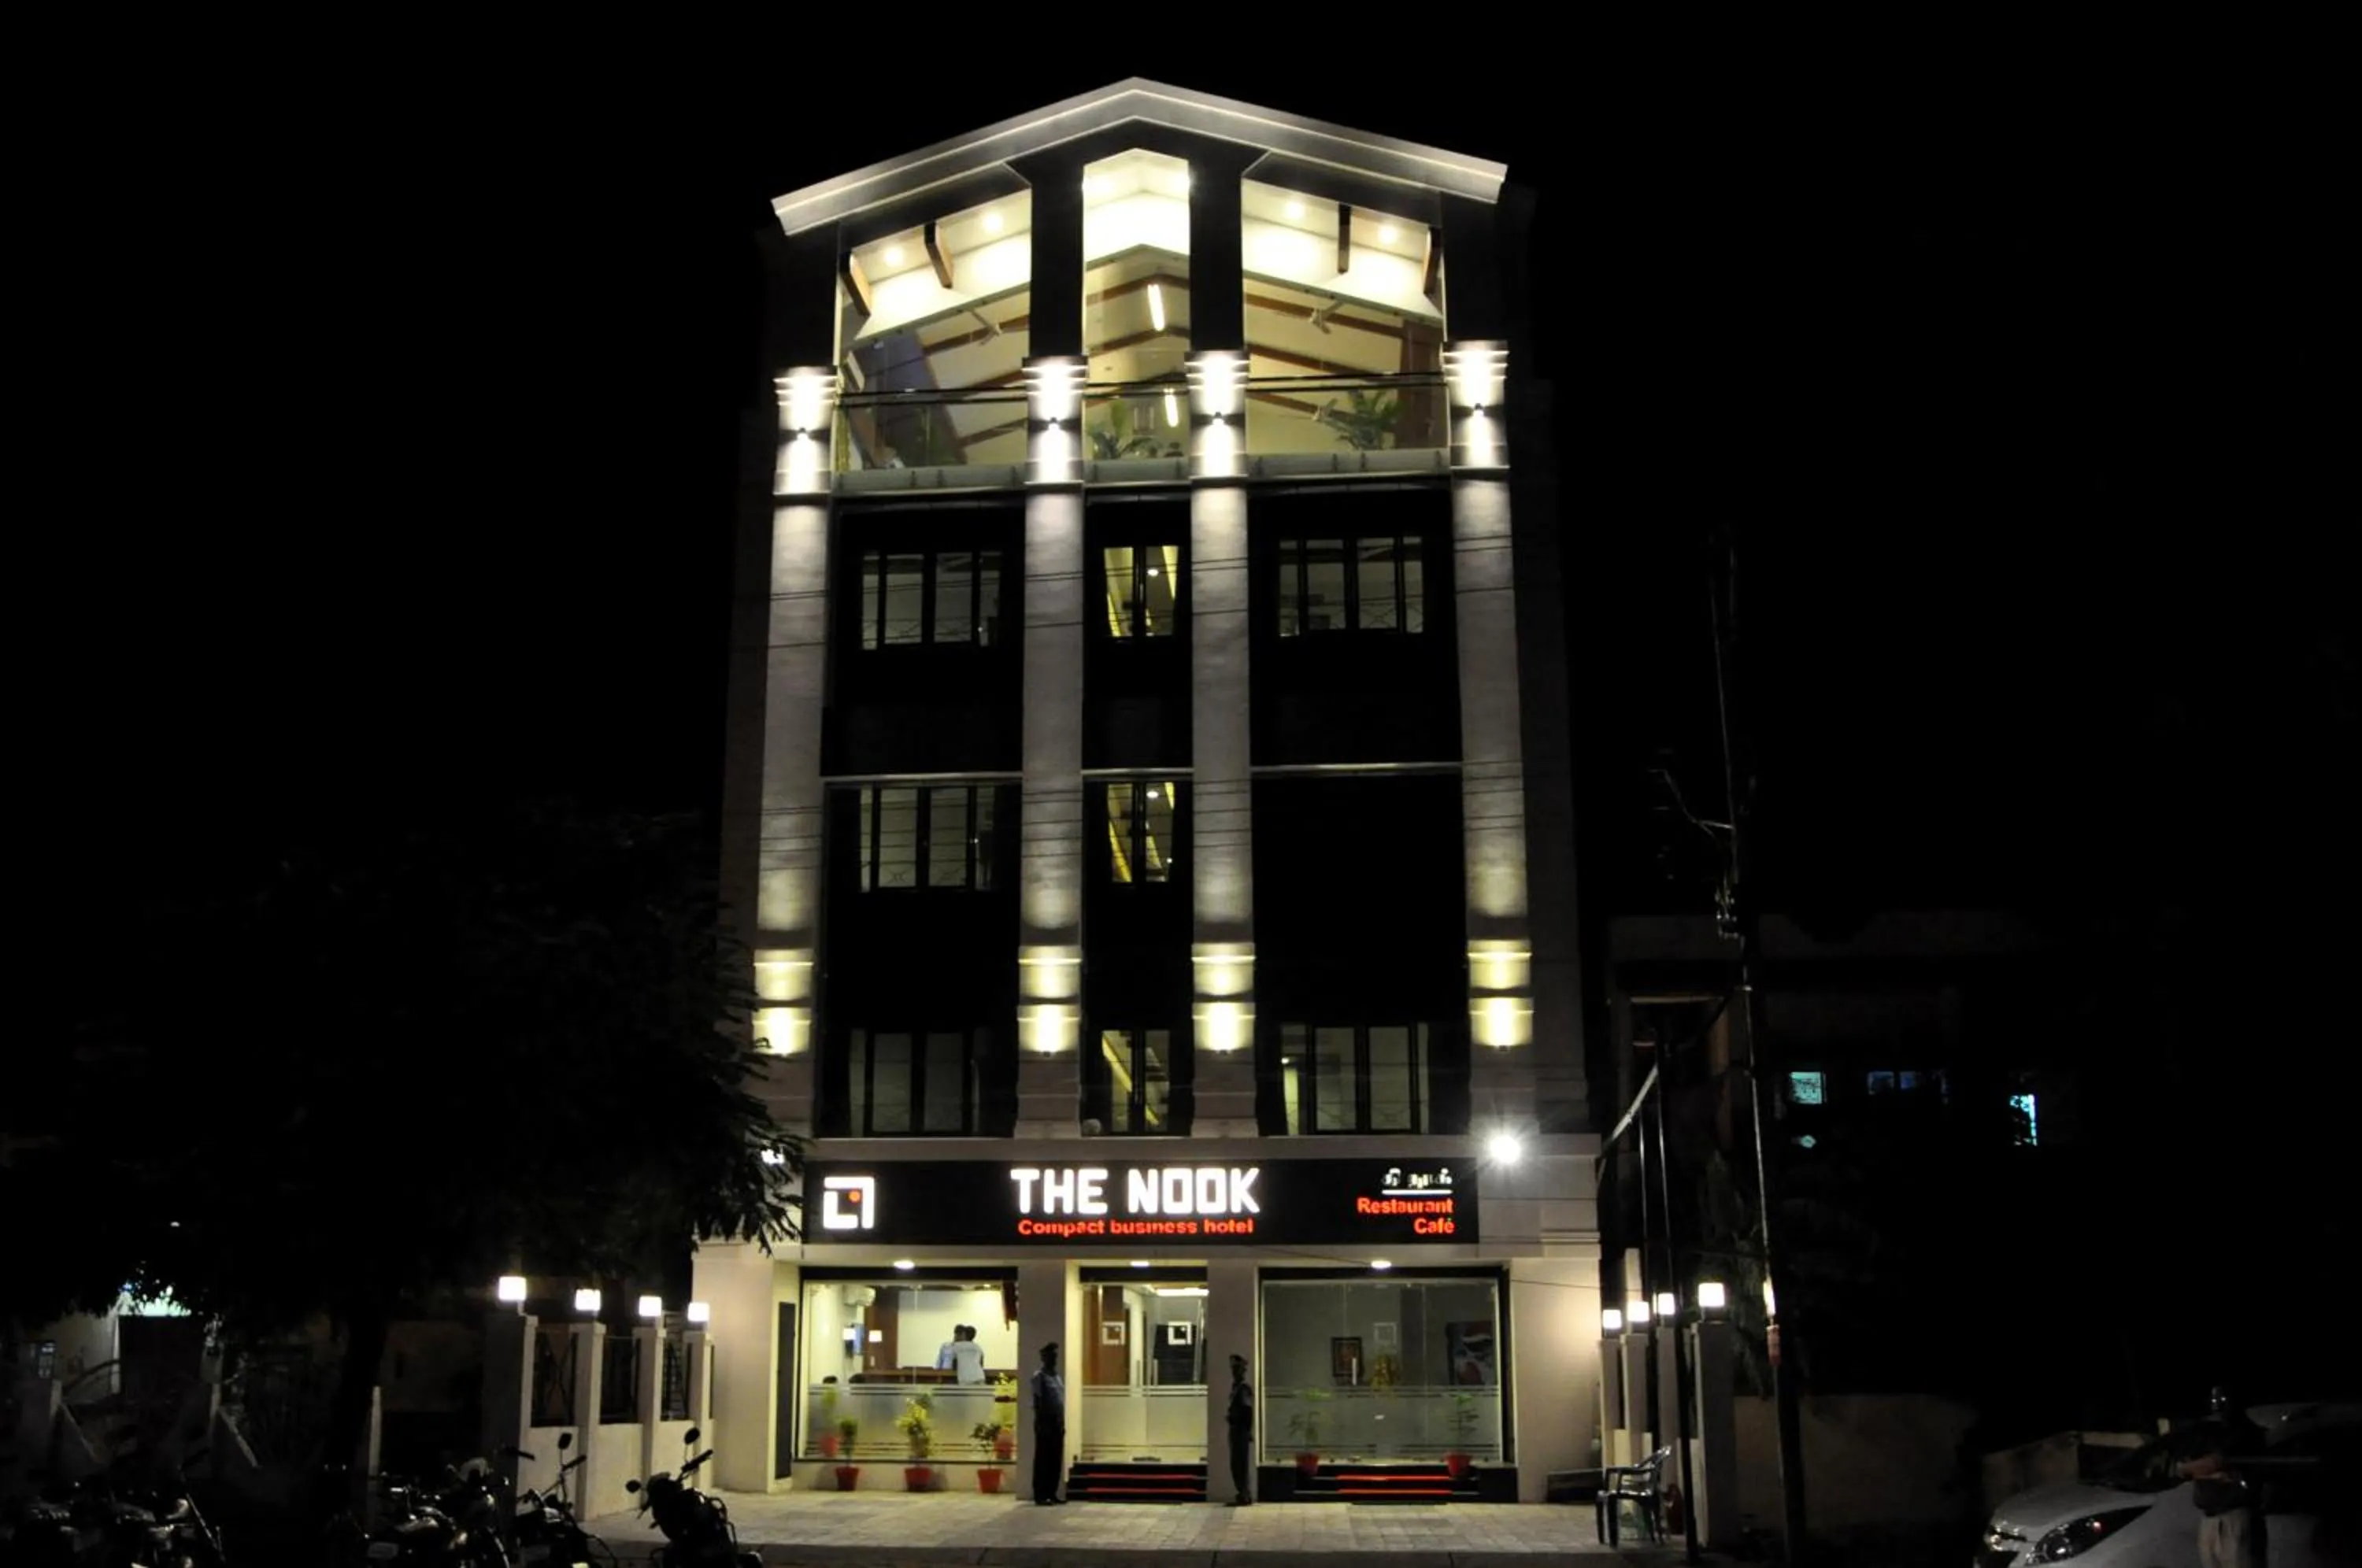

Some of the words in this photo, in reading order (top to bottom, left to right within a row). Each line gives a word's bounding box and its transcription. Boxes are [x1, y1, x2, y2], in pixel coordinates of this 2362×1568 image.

[1010, 1168, 1109, 1214] THE
[1127, 1167, 1261, 1214] NOOK
[1357, 1196, 1454, 1214] Restaurant
[1018, 1219, 1105, 1237] Compact
[1110, 1219, 1197, 1234] business
[1204, 1218, 1253, 1233] hotel
